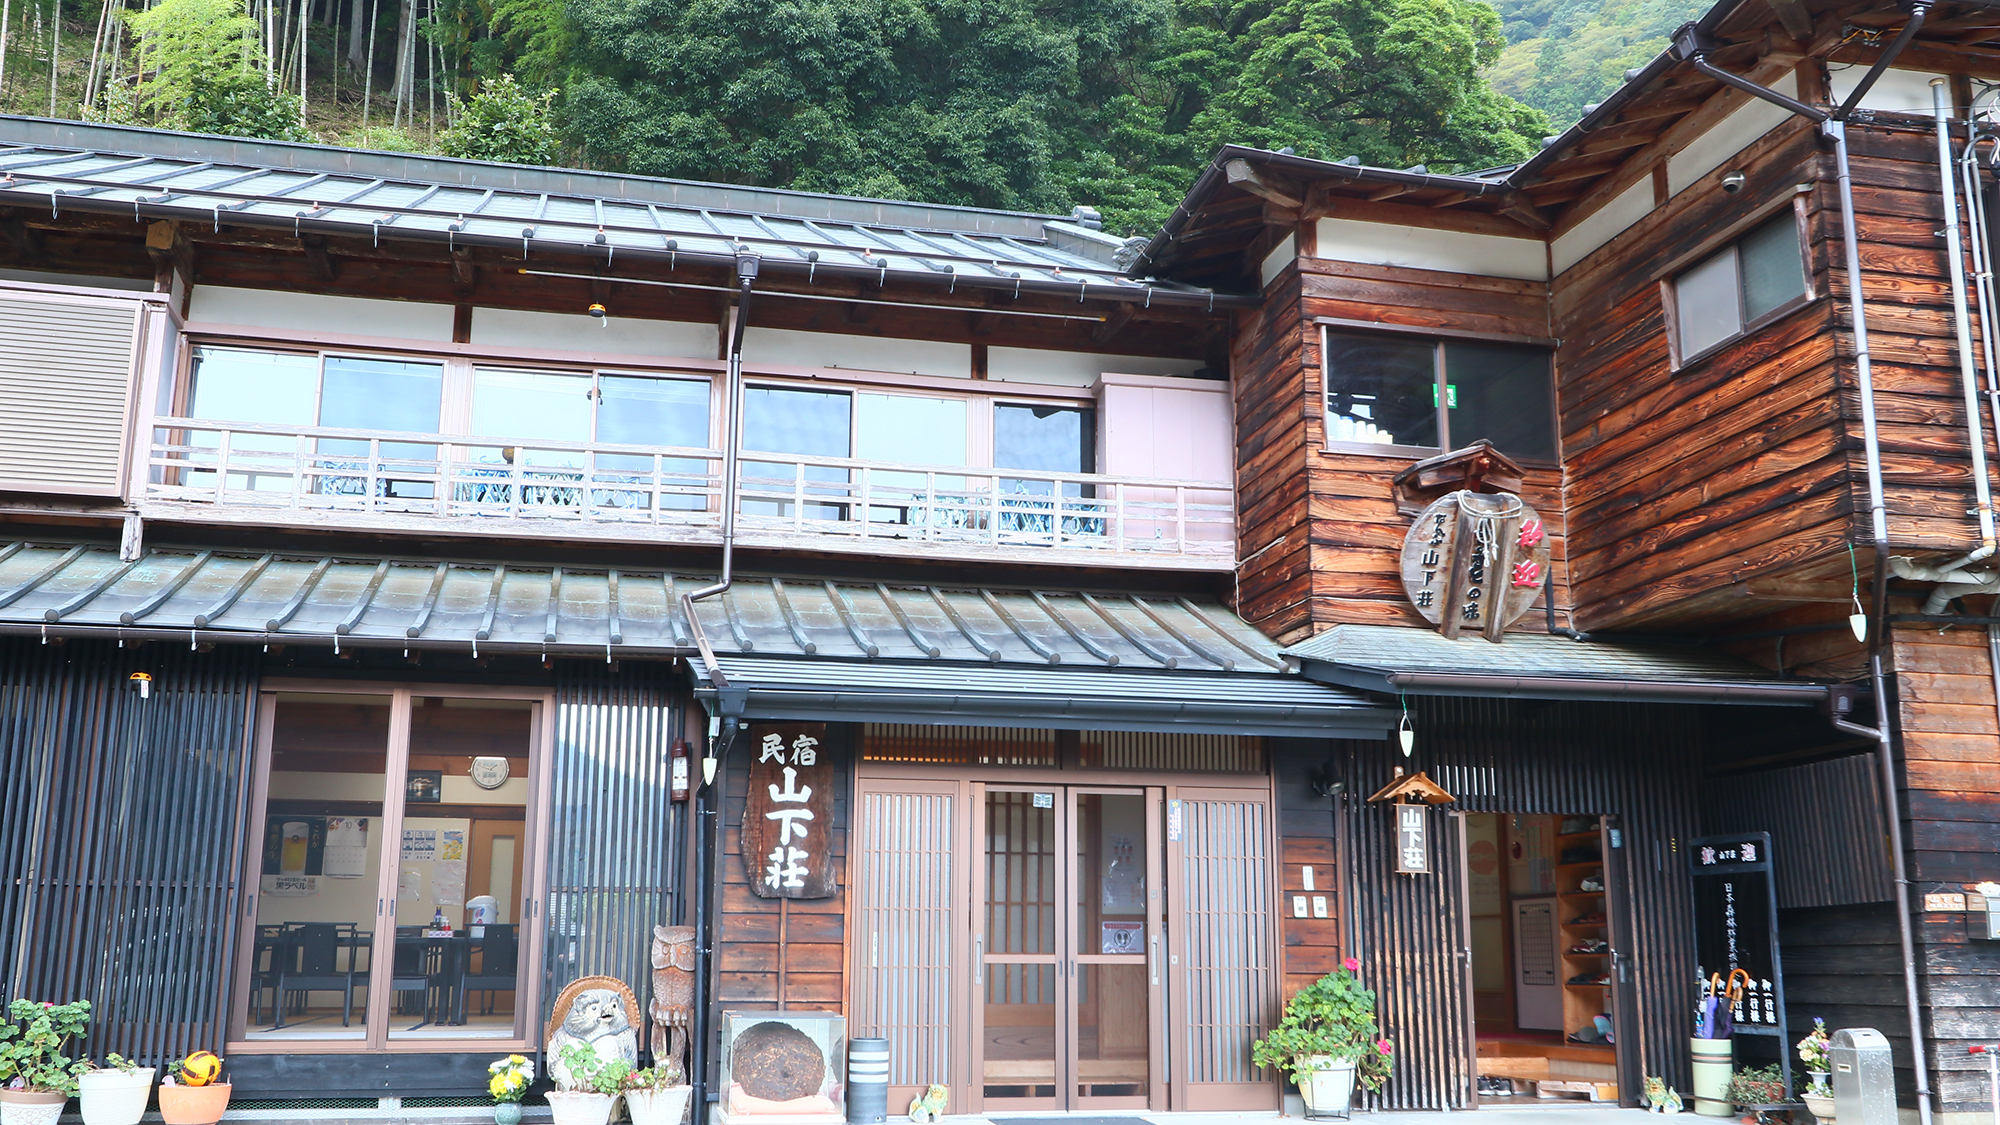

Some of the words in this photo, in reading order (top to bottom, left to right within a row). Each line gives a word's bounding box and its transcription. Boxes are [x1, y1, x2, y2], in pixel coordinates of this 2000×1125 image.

[1416, 549, 1439, 608] 山下荘
[1511, 518, 1545, 589] 歓迎
[758, 732, 819, 766] 民宿
[764, 766, 815, 889] 山下荘
[1402, 808, 1424, 869] 山下荘
[275, 882, 307, 890] 黒ラベル
